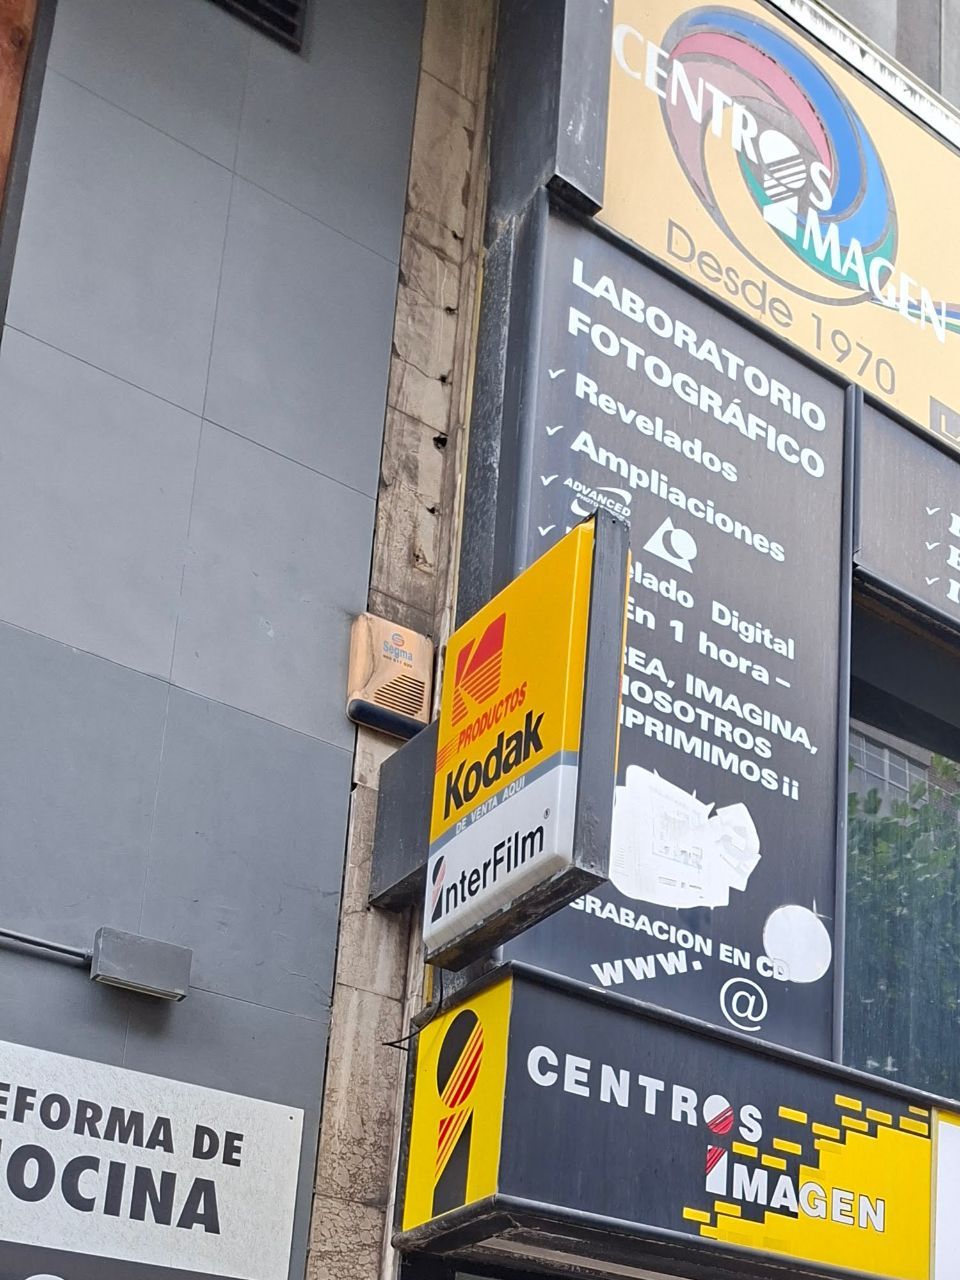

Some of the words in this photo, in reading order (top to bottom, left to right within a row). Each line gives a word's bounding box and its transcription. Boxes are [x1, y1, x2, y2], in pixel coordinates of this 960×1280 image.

[612, 23, 833, 212] CENTROS
[572, 257, 826, 432] LABORATORIO
[666, 218, 793, 328] Desde
[811, 312, 897, 396] 1970
[568, 306, 825, 478] FOTOGRÁFICO
[575, 372, 738, 482] Revelados
[563, 477, 631, 517] ADVANCED
[570, 431, 785, 562] Ampliaciones
[669, 619, 684, 643] 1
[698, 631, 769, 685] hora
[711, 600, 795, 660] Digital
[457, 682, 528, 754] PRODUCTOS
[686, 673, 818, 755] IMAGINA,
[443, 711, 545, 821] Kodak
[455, 816, 468, 835] DE
[469, 797, 499, 826] VENTA
[568, 895, 713, 957] GRABACION
[719, 943, 751, 970] EN
[719, 977, 768, 1031] @
[526, 1045, 763, 1142] CENTROS
[0, 1139, 221, 1235] OCINA
[192, 1123, 244, 1167] DE
[705, 1144, 886, 1233] IMAGEN
